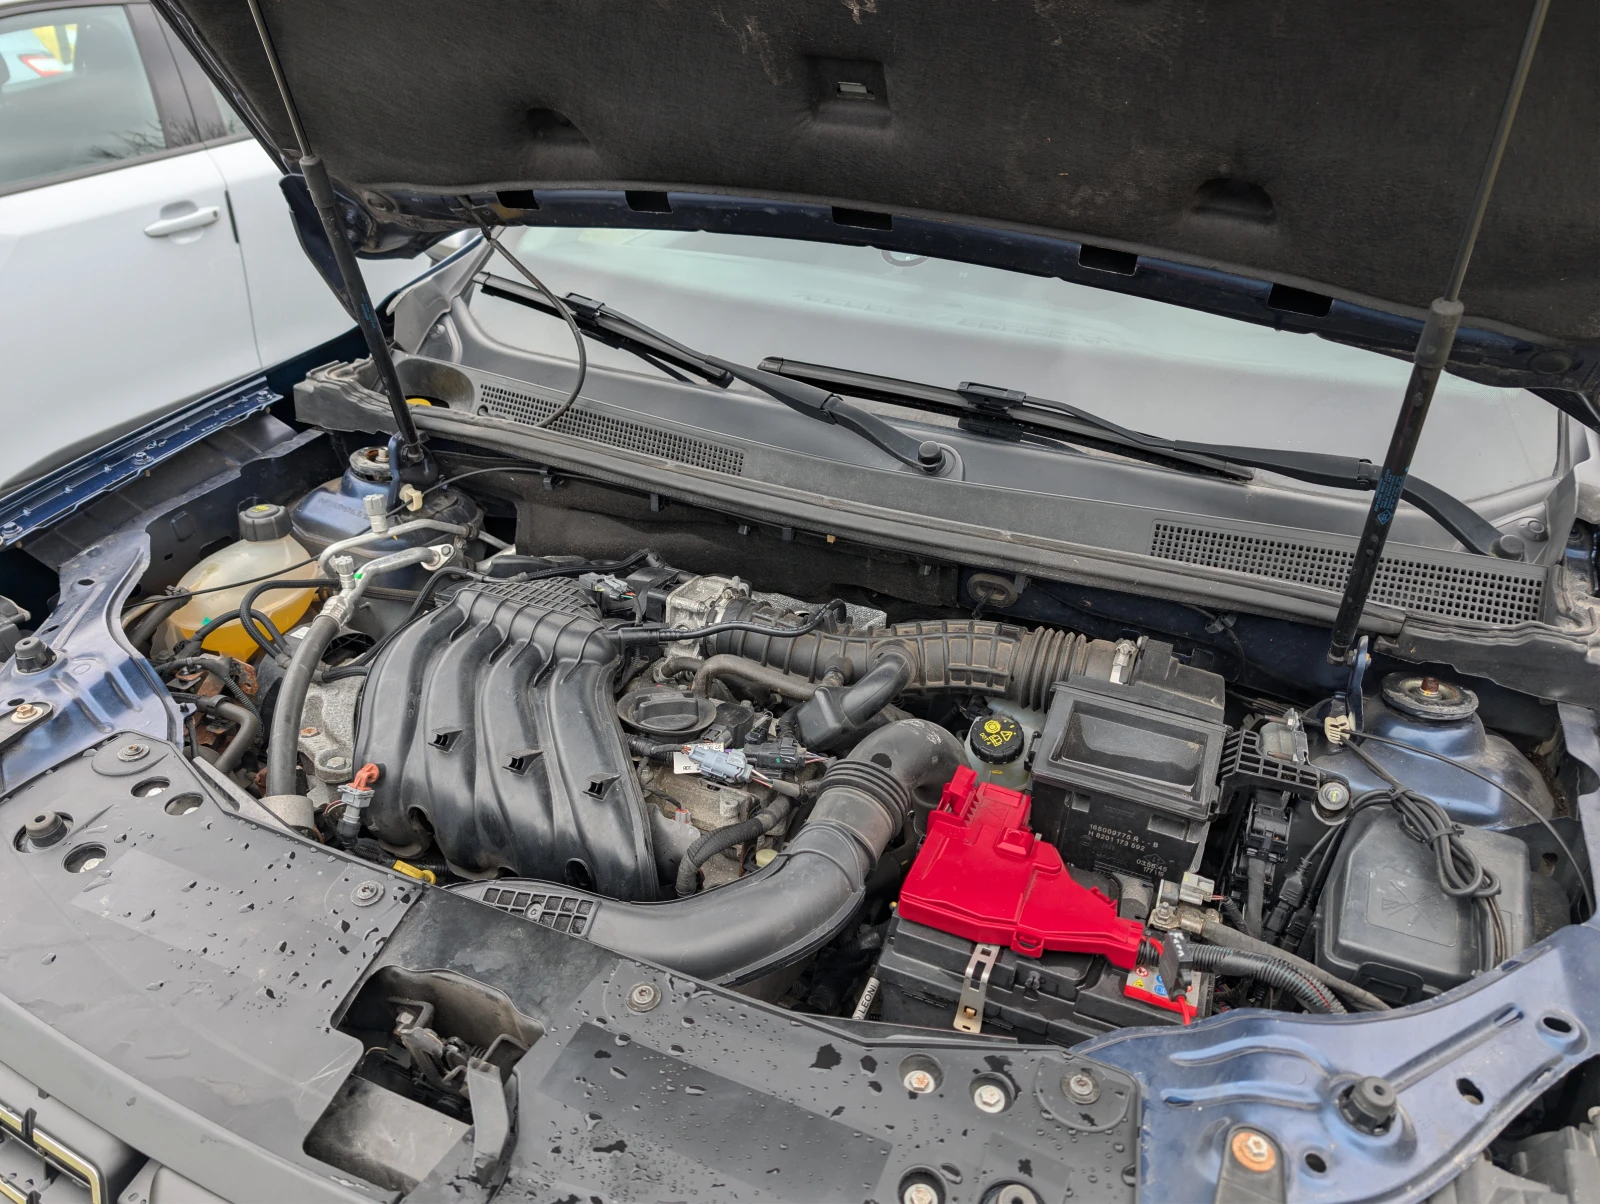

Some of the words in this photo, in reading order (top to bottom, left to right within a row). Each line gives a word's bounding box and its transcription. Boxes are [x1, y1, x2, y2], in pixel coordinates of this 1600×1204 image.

[1095, 832, 1114, 842] 8201
[1116, 838, 1129, 847] 173
[858, 984, 877, 1014] LEONI
